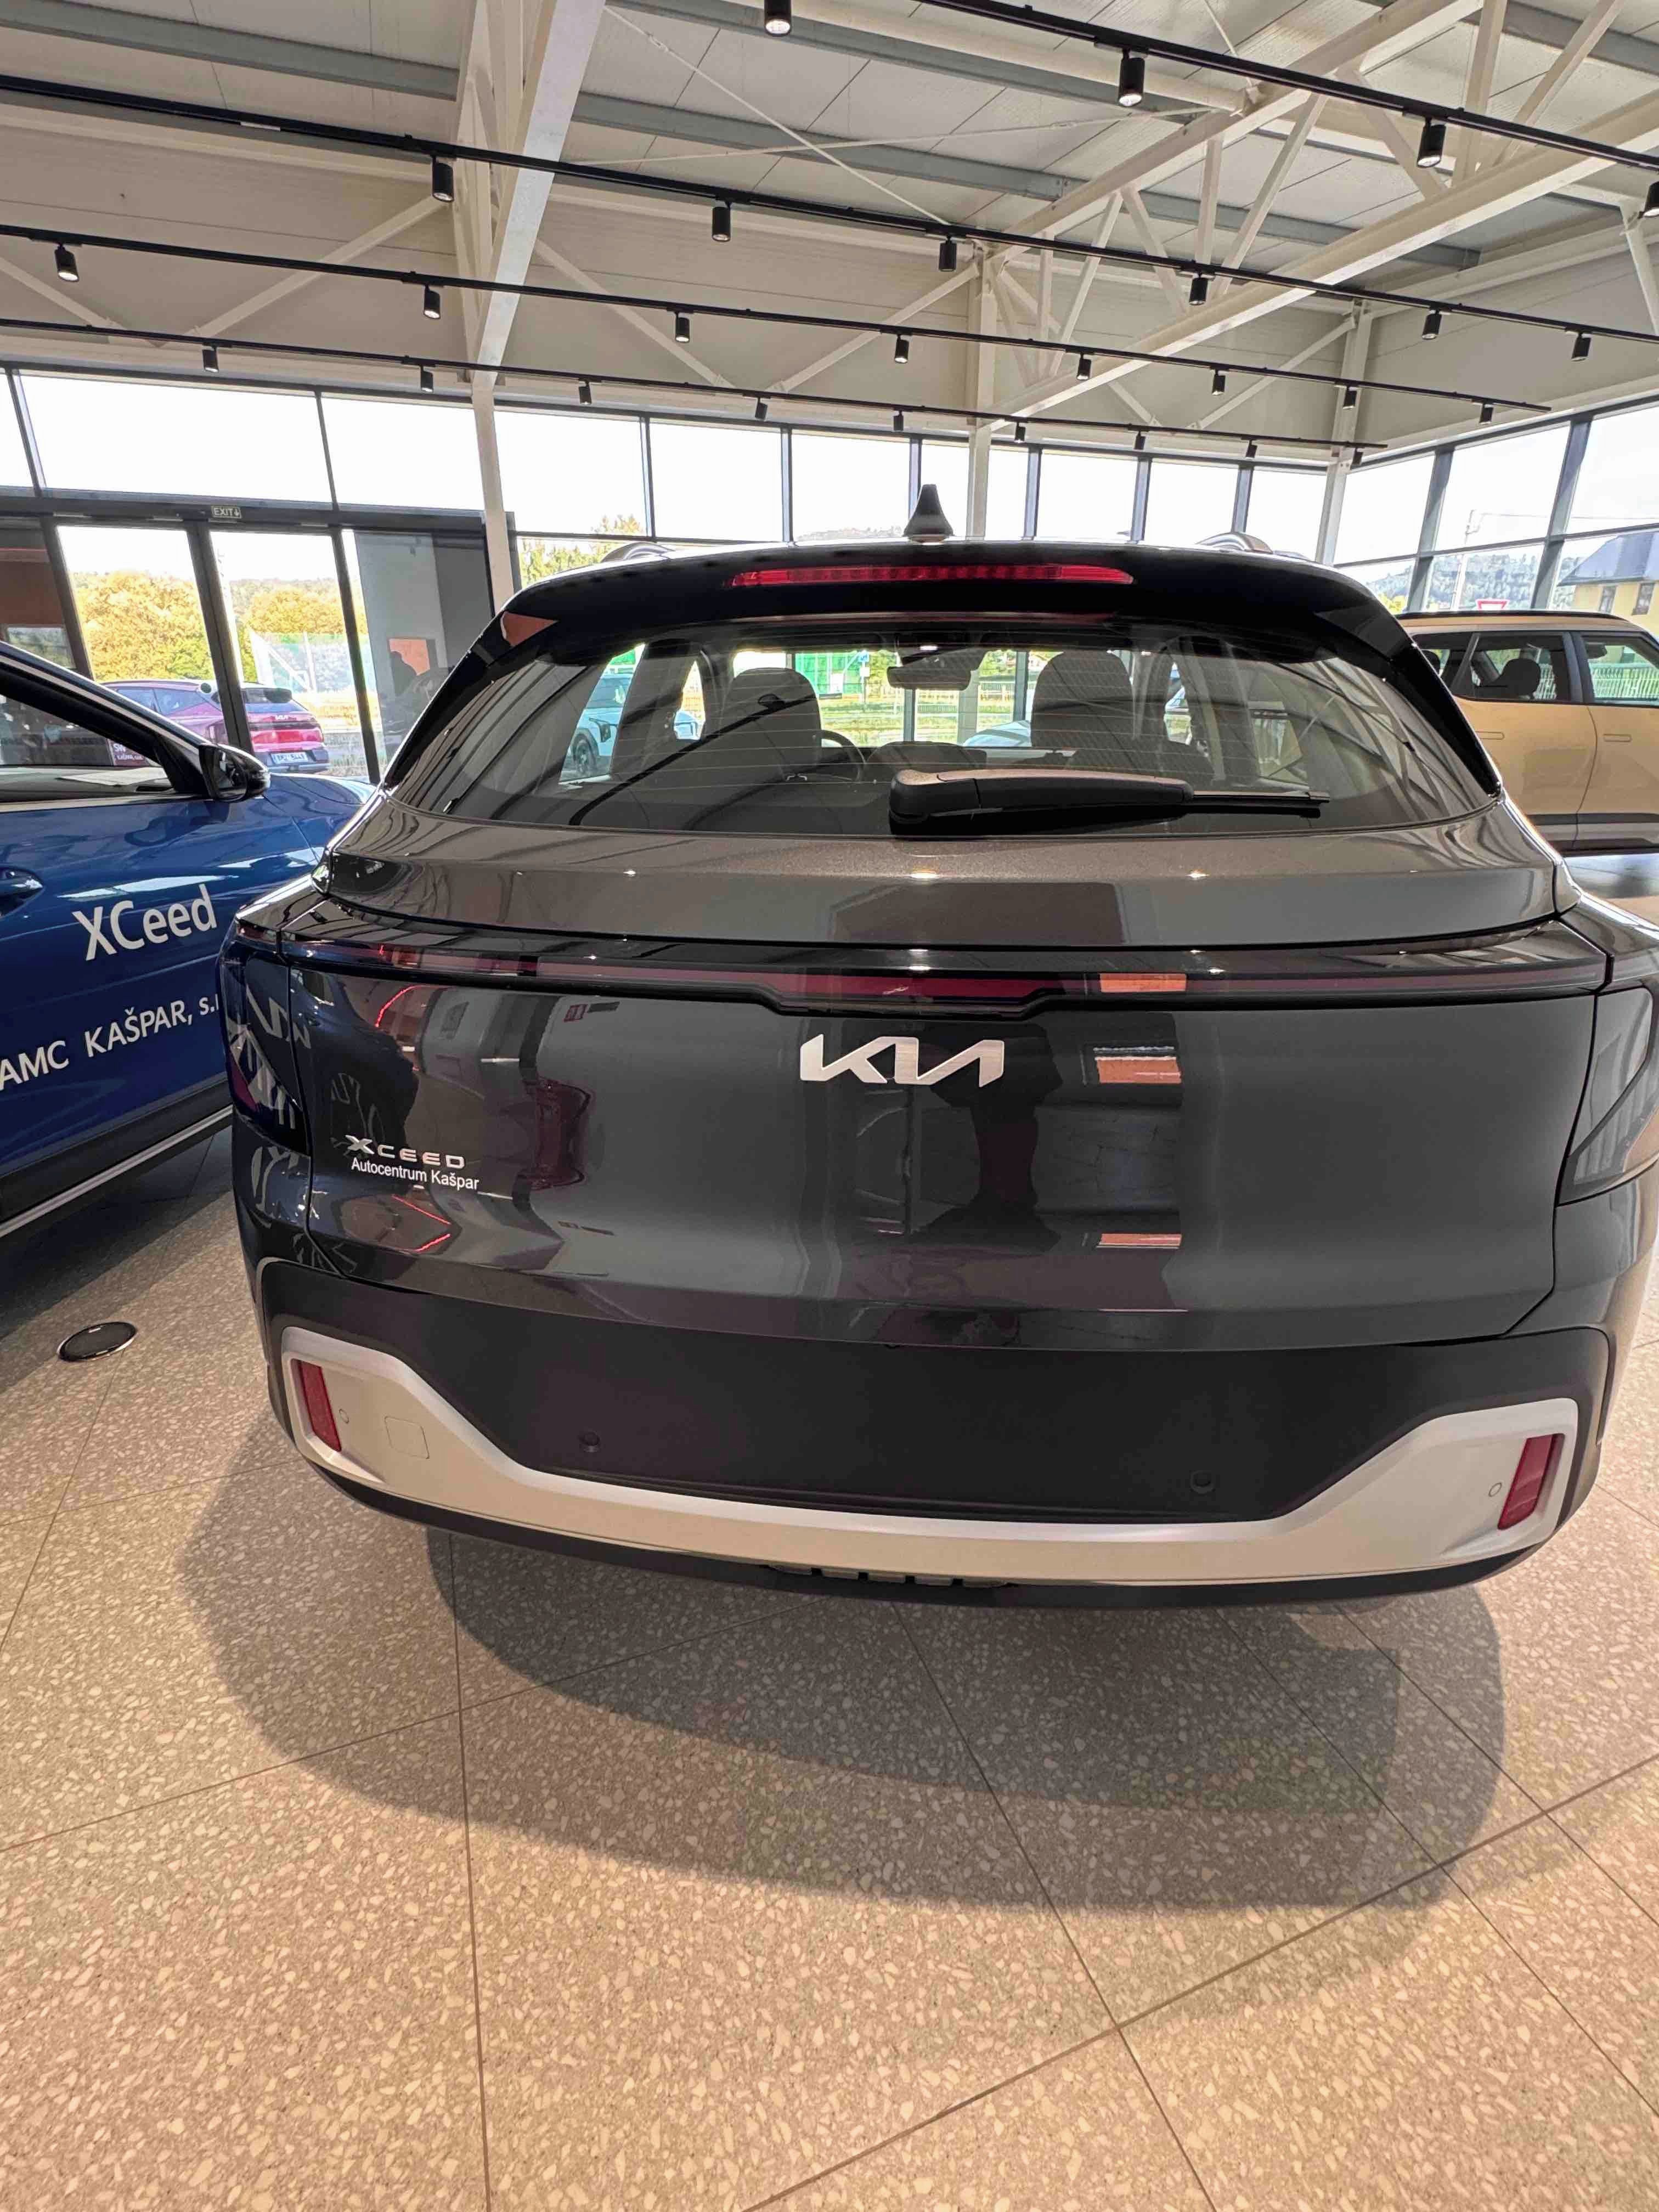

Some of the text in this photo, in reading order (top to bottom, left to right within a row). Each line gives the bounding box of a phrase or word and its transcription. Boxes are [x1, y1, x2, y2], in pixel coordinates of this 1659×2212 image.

[214, 507, 233, 516] EXIT
[72, 883, 217, 961] XCeed
[0, 1040, 69, 1091] AMC
[84, 1000, 193, 1058] KAŠPAR,
[800, 1034, 1005, 1087] KIA
[345, 1135, 465, 1169] XCEED
[351, 1157, 479, 1191] Autocentrum Kašpar
